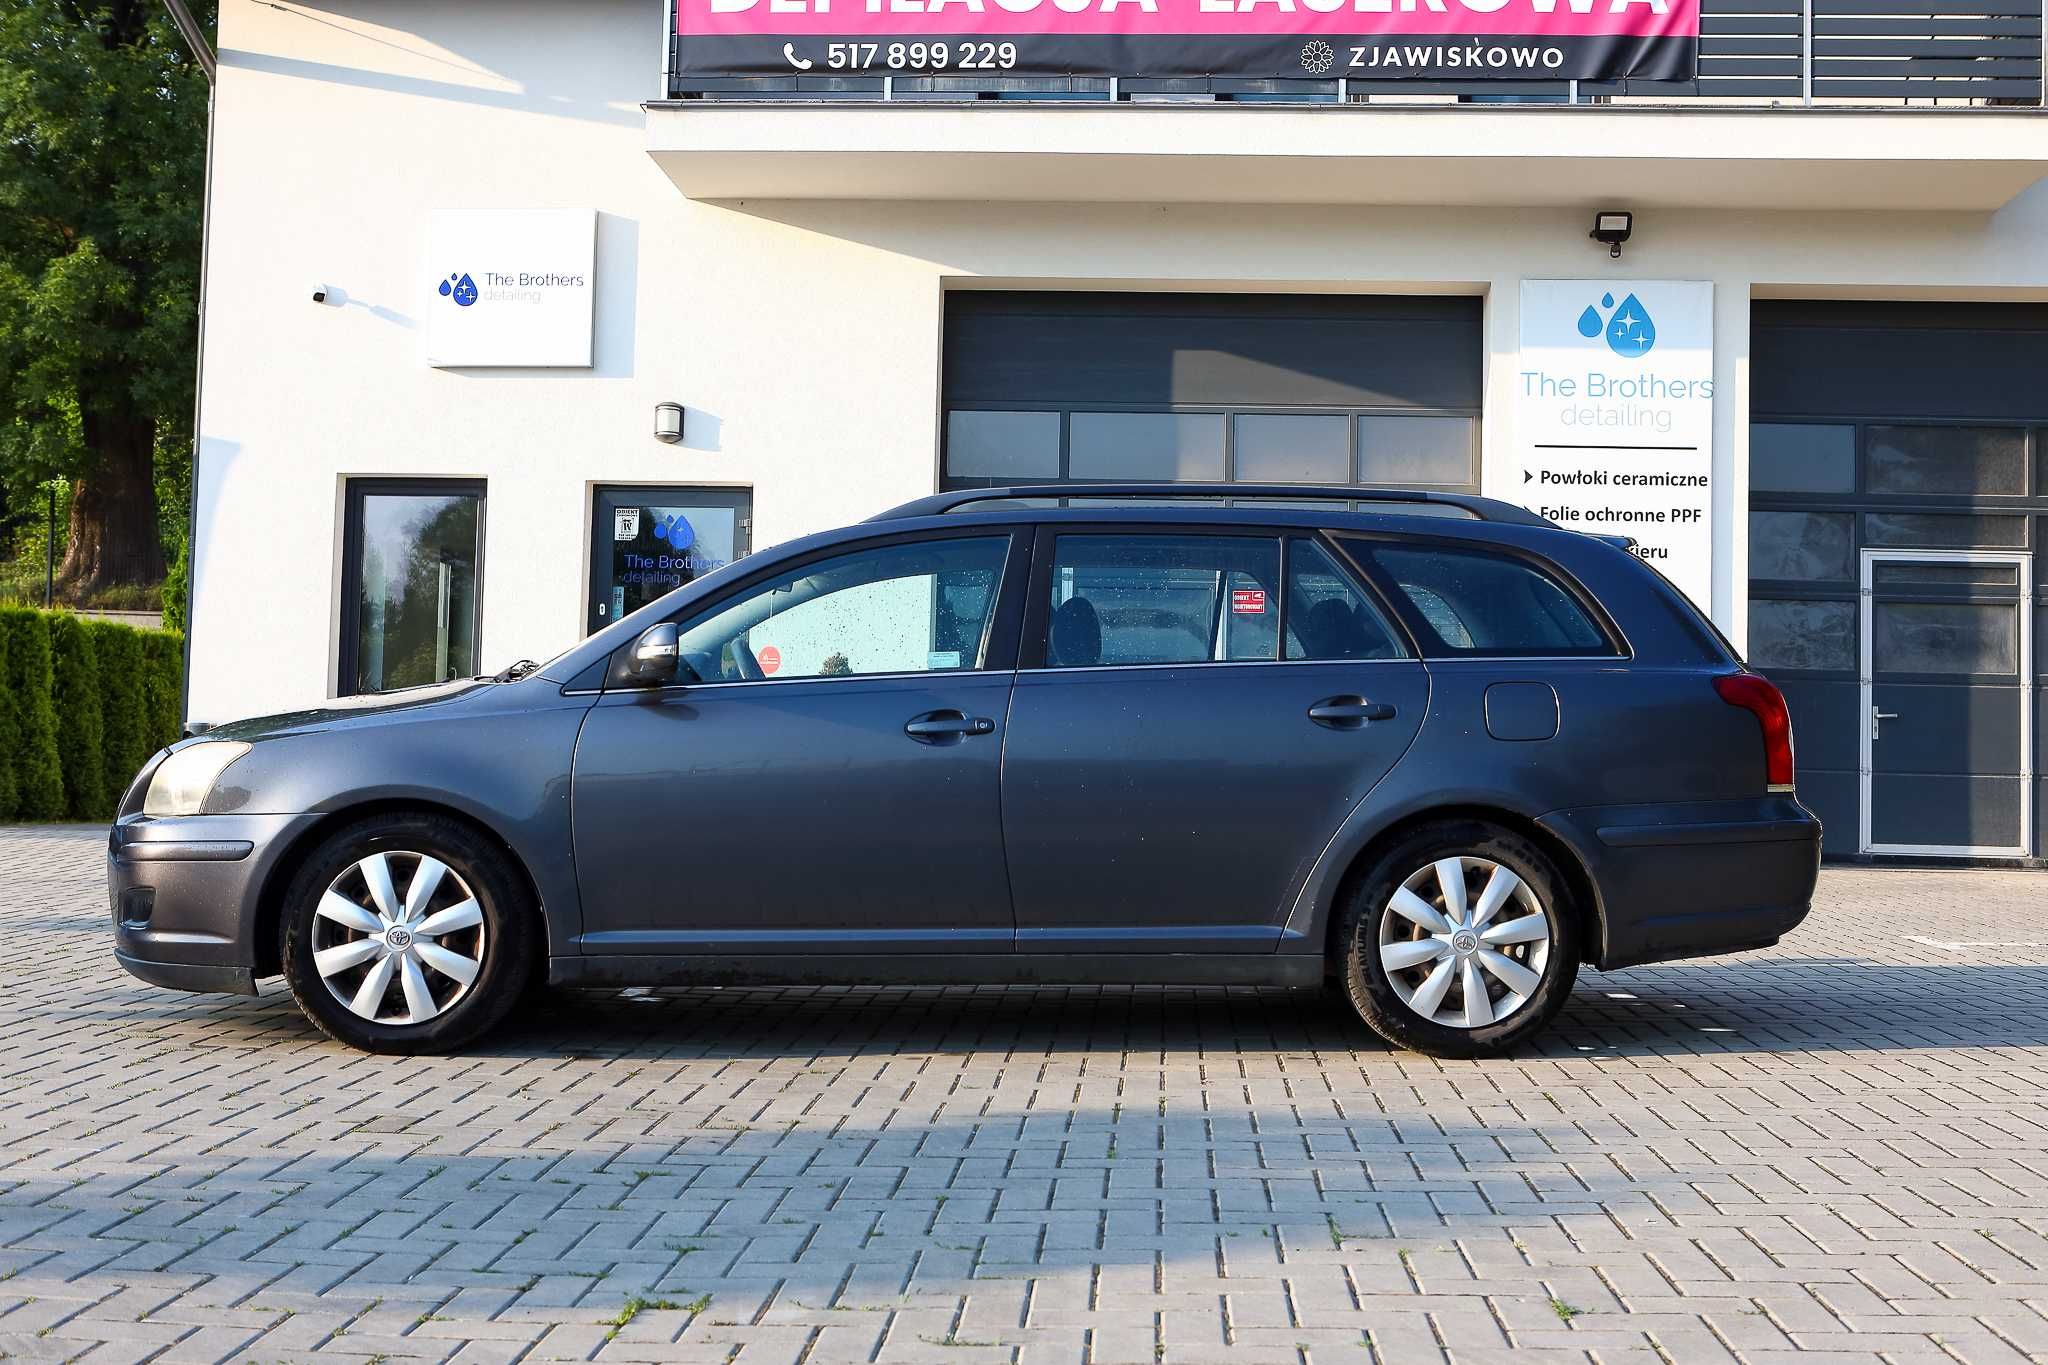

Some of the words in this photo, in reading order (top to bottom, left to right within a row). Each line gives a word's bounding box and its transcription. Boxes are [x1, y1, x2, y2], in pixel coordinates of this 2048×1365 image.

[827, 43, 878, 69] 517
[886, 42, 949, 69] 899
[958, 42, 1017, 69] 229
[1348, 45, 1564, 68] ZJAWISKOWO
[485, 272, 514, 287] The
[519, 272, 584, 287] Brothers
[484, 289, 542, 305] detailing
[1520, 372, 1577, 398] The
[1587, 373, 1714, 400] Brothers
[1560, 404, 1673, 433] detailing
[1540, 470, 1608, 486] Powłoki
[1612, 471, 1708, 487] ceramiczne
[1540, 507, 1580, 522] Folie
[1585, 506, 1666, 523] ochronne
[1671, 508, 1702, 523] PPF
[624, 554, 653, 569] The
[658, 555, 725, 570] Brothers
[623, 571, 681, 587] detailing
